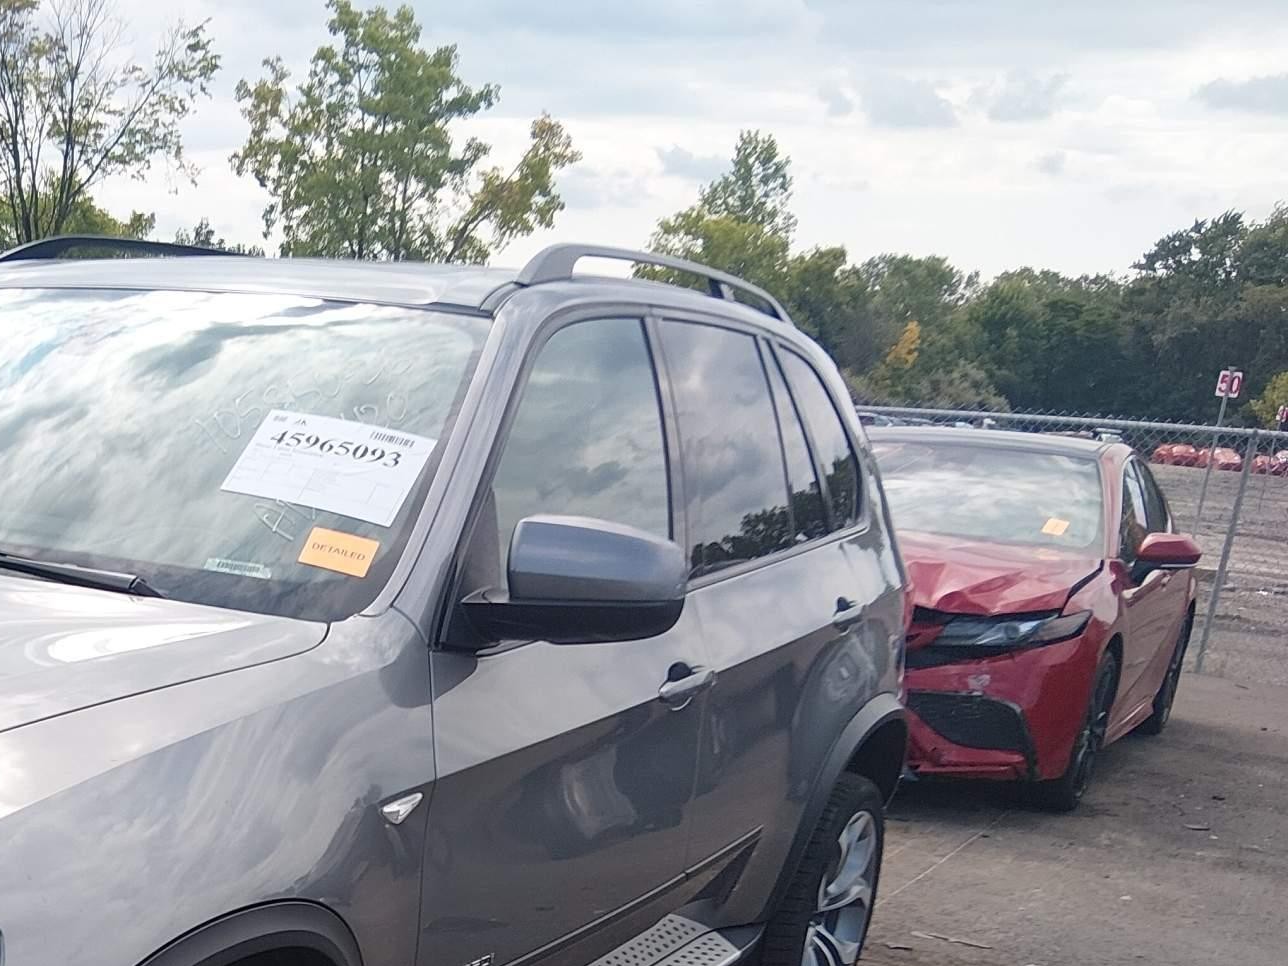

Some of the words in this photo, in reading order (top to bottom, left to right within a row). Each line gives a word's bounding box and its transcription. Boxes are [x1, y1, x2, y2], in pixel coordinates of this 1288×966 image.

[1218, 374, 1241, 394] 50
[270, 430, 402, 468] 45965093
[312, 542, 366, 561] DETAILED
